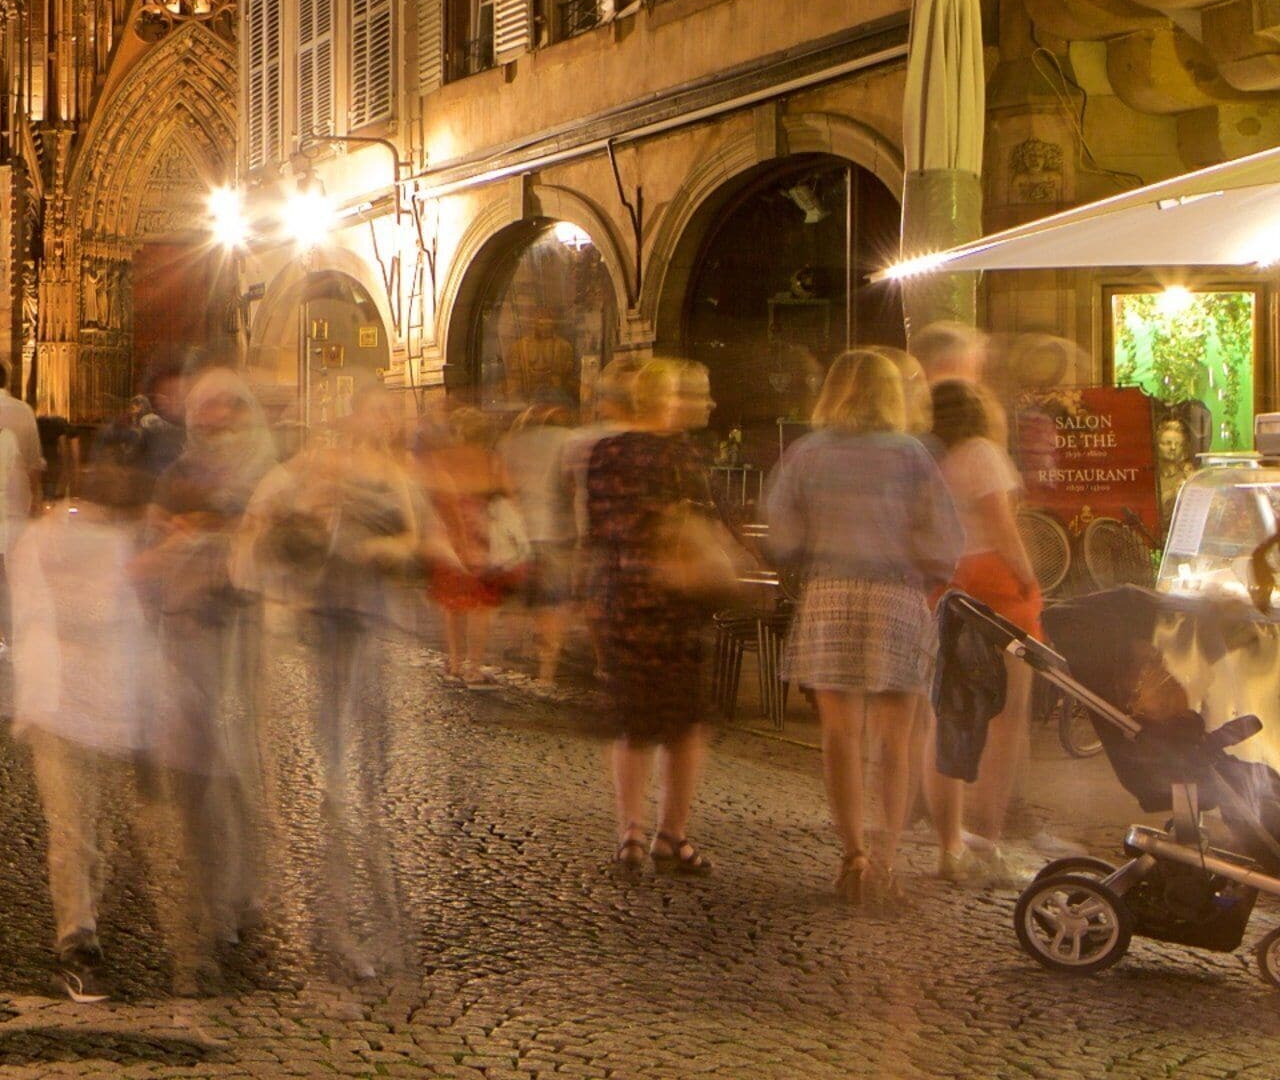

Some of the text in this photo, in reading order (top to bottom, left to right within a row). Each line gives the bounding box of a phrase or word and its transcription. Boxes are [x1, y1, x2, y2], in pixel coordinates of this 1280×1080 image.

[1055, 414, 1112, 429] SALON
[1055, 430, 1118, 448] DE THÉ
[1039, 468, 1139, 481] RESTAURANT
